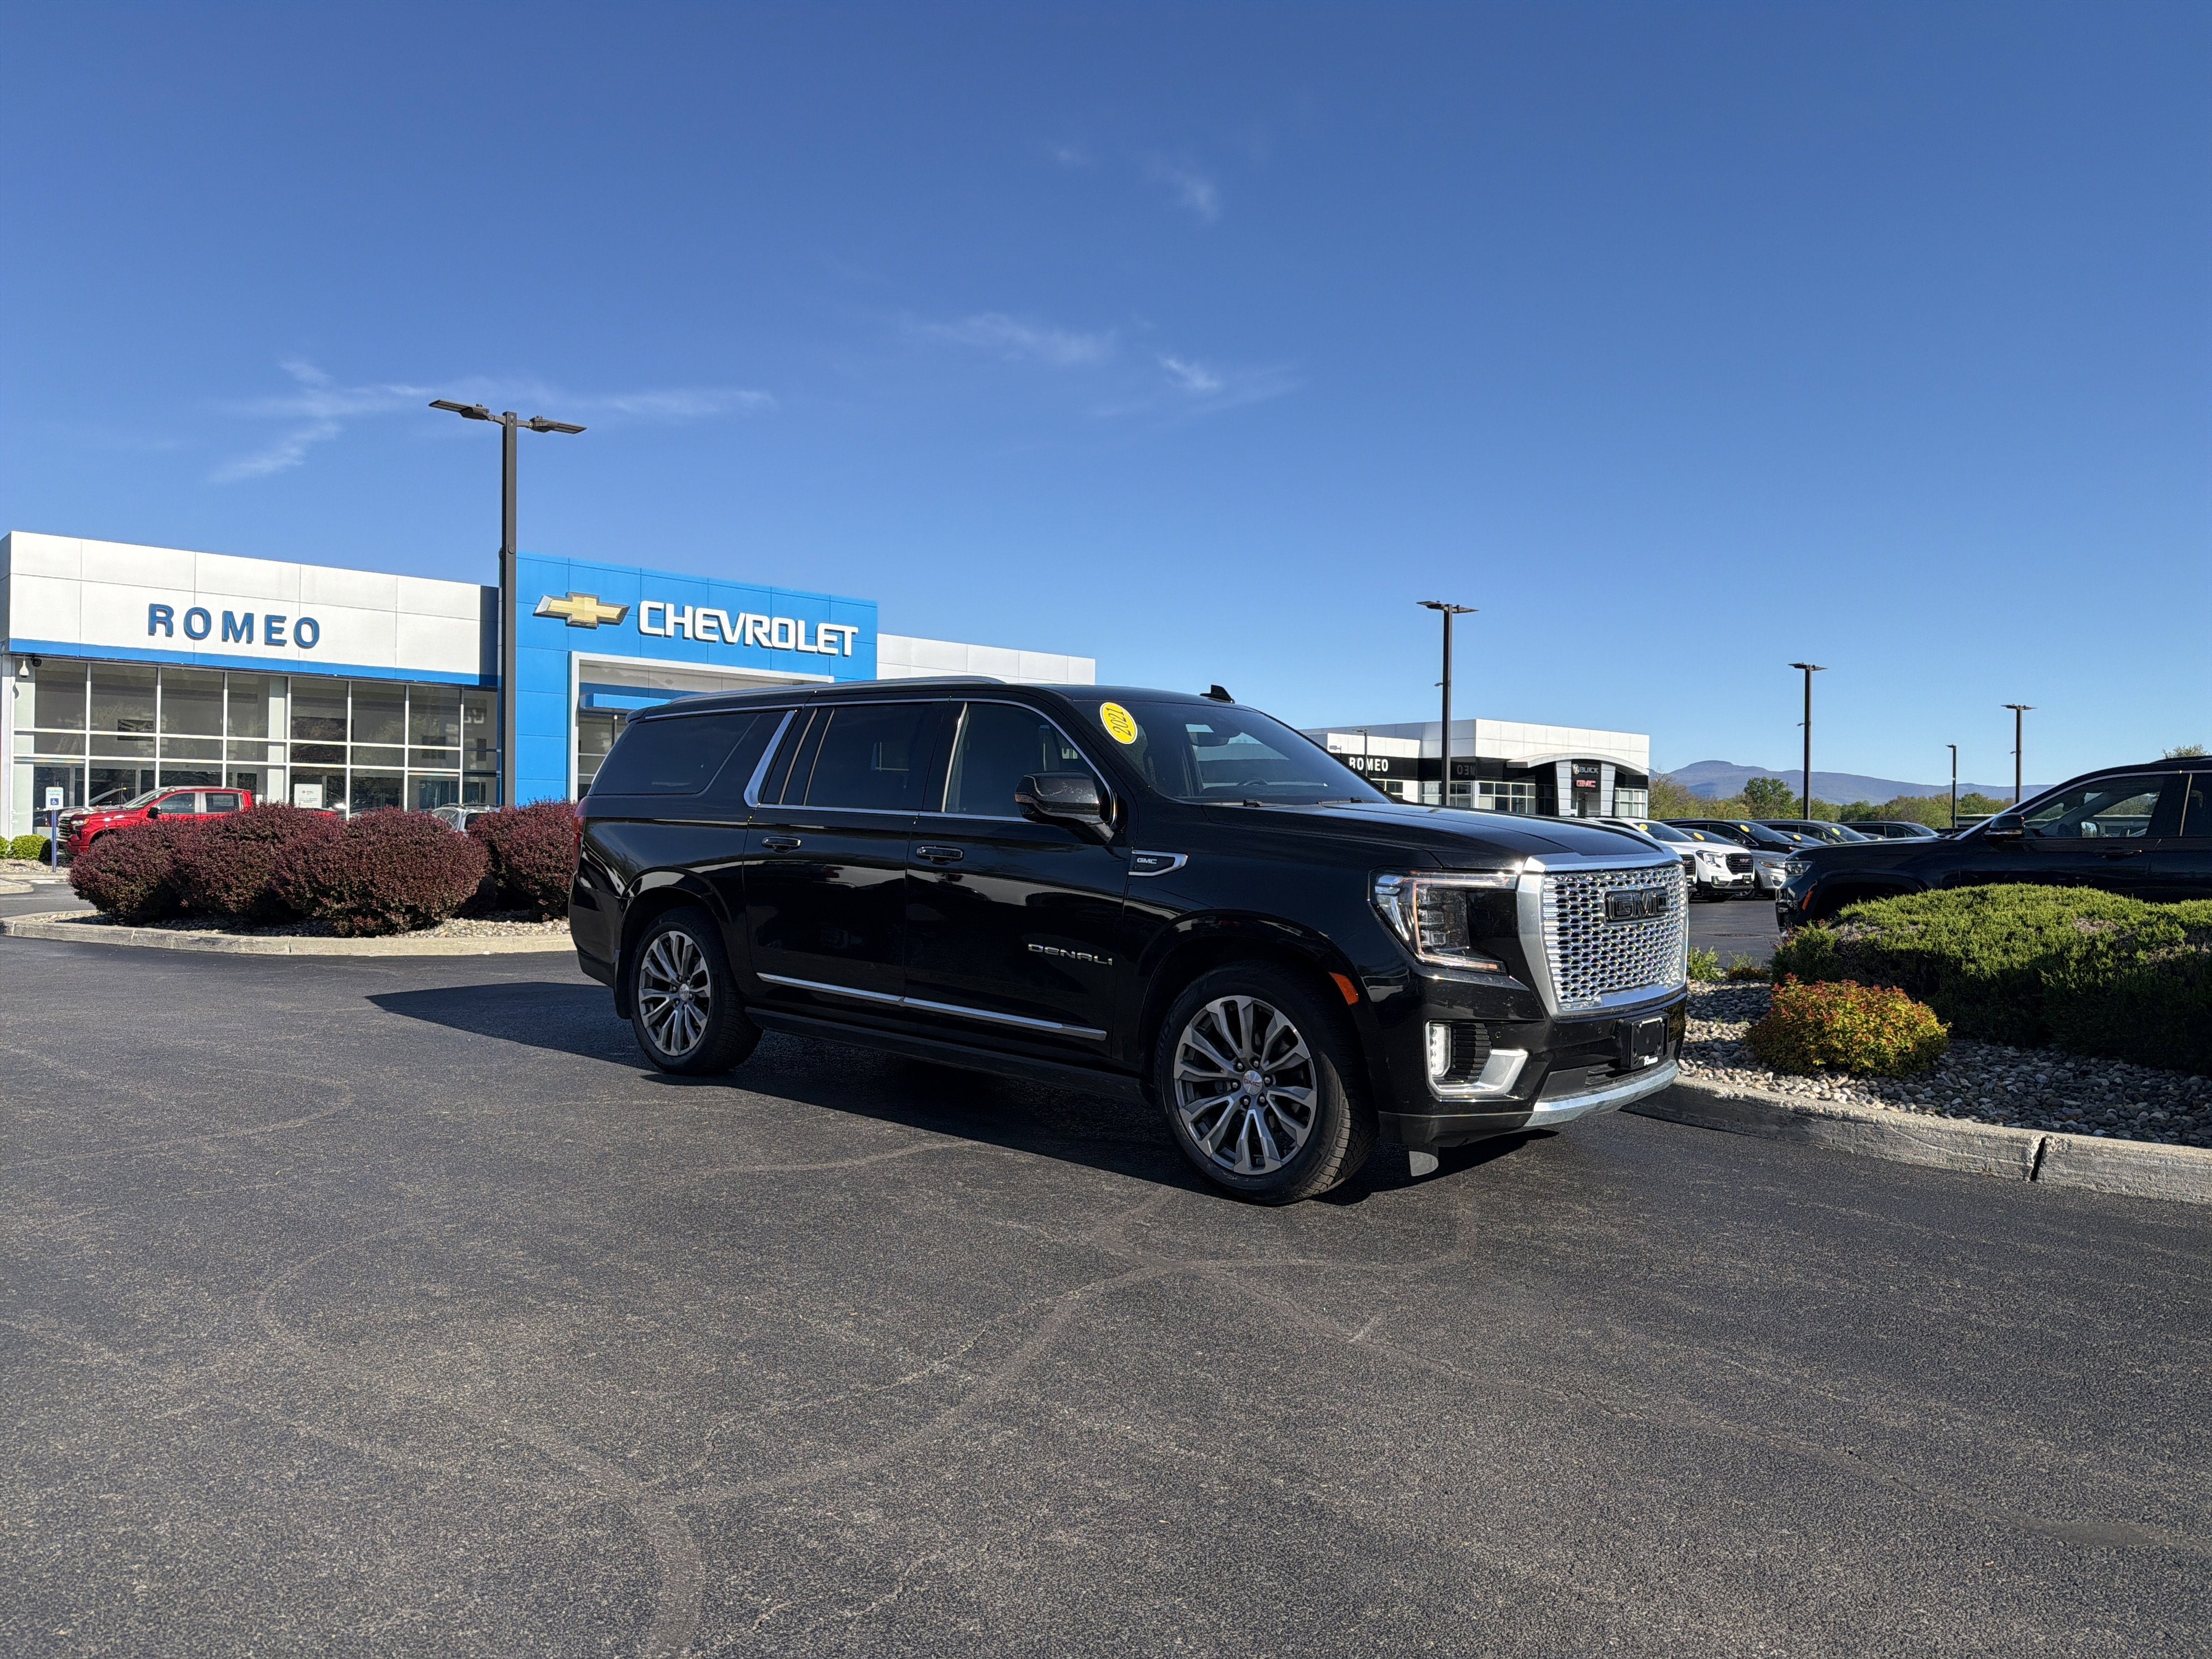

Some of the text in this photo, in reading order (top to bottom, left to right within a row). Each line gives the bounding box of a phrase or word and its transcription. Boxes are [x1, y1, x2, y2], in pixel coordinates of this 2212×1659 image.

[148, 603, 320, 650] ROMEO
[639, 600, 859, 657] CHEVROLET
[1105, 707, 1132, 737] 2021
[1348, 757, 1389, 772] ROMEO
[1607, 888, 1668, 921] GMC
[1028, 943, 1113, 966] DENALI
[1243, 1079, 1261, 1087] GMC
